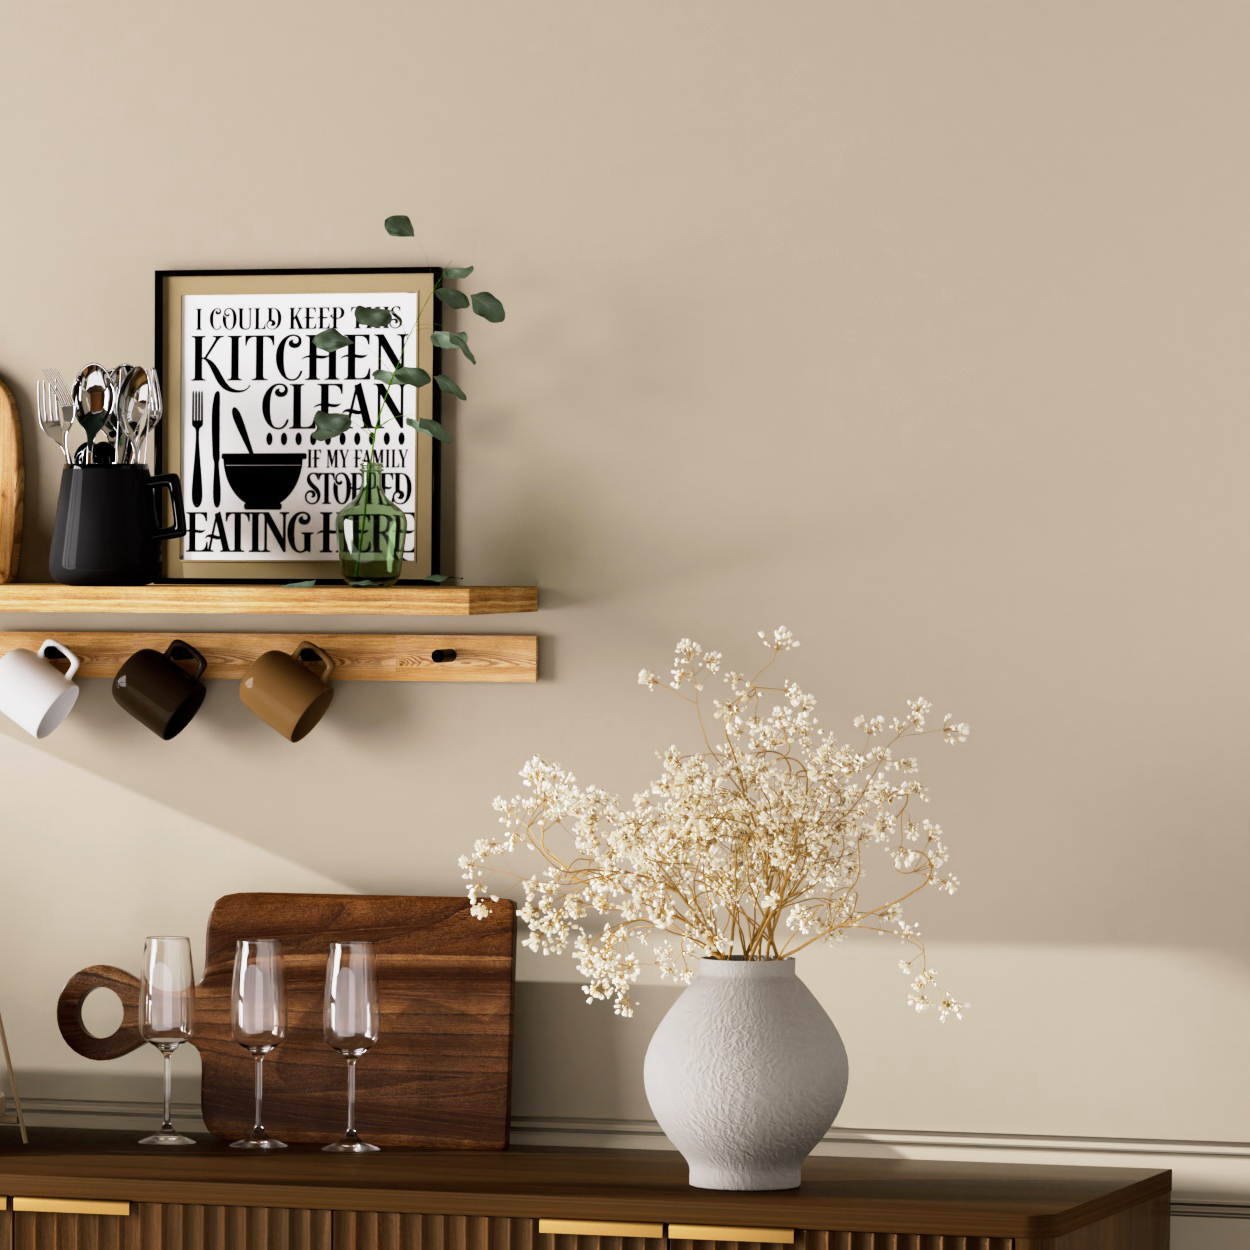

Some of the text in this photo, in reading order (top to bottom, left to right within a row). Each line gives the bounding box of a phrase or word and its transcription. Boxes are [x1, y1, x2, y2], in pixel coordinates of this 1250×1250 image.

[196, 308, 202, 330] I
[209, 307, 282, 330] COULD
[289, 306, 345, 330] KEEP
[191, 334, 409, 393] KITCHEN
[262, 383, 406, 430] CLEAN
[307, 449, 409, 468] IF MY FAMILY
[186, 511, 313, 553] EATING
